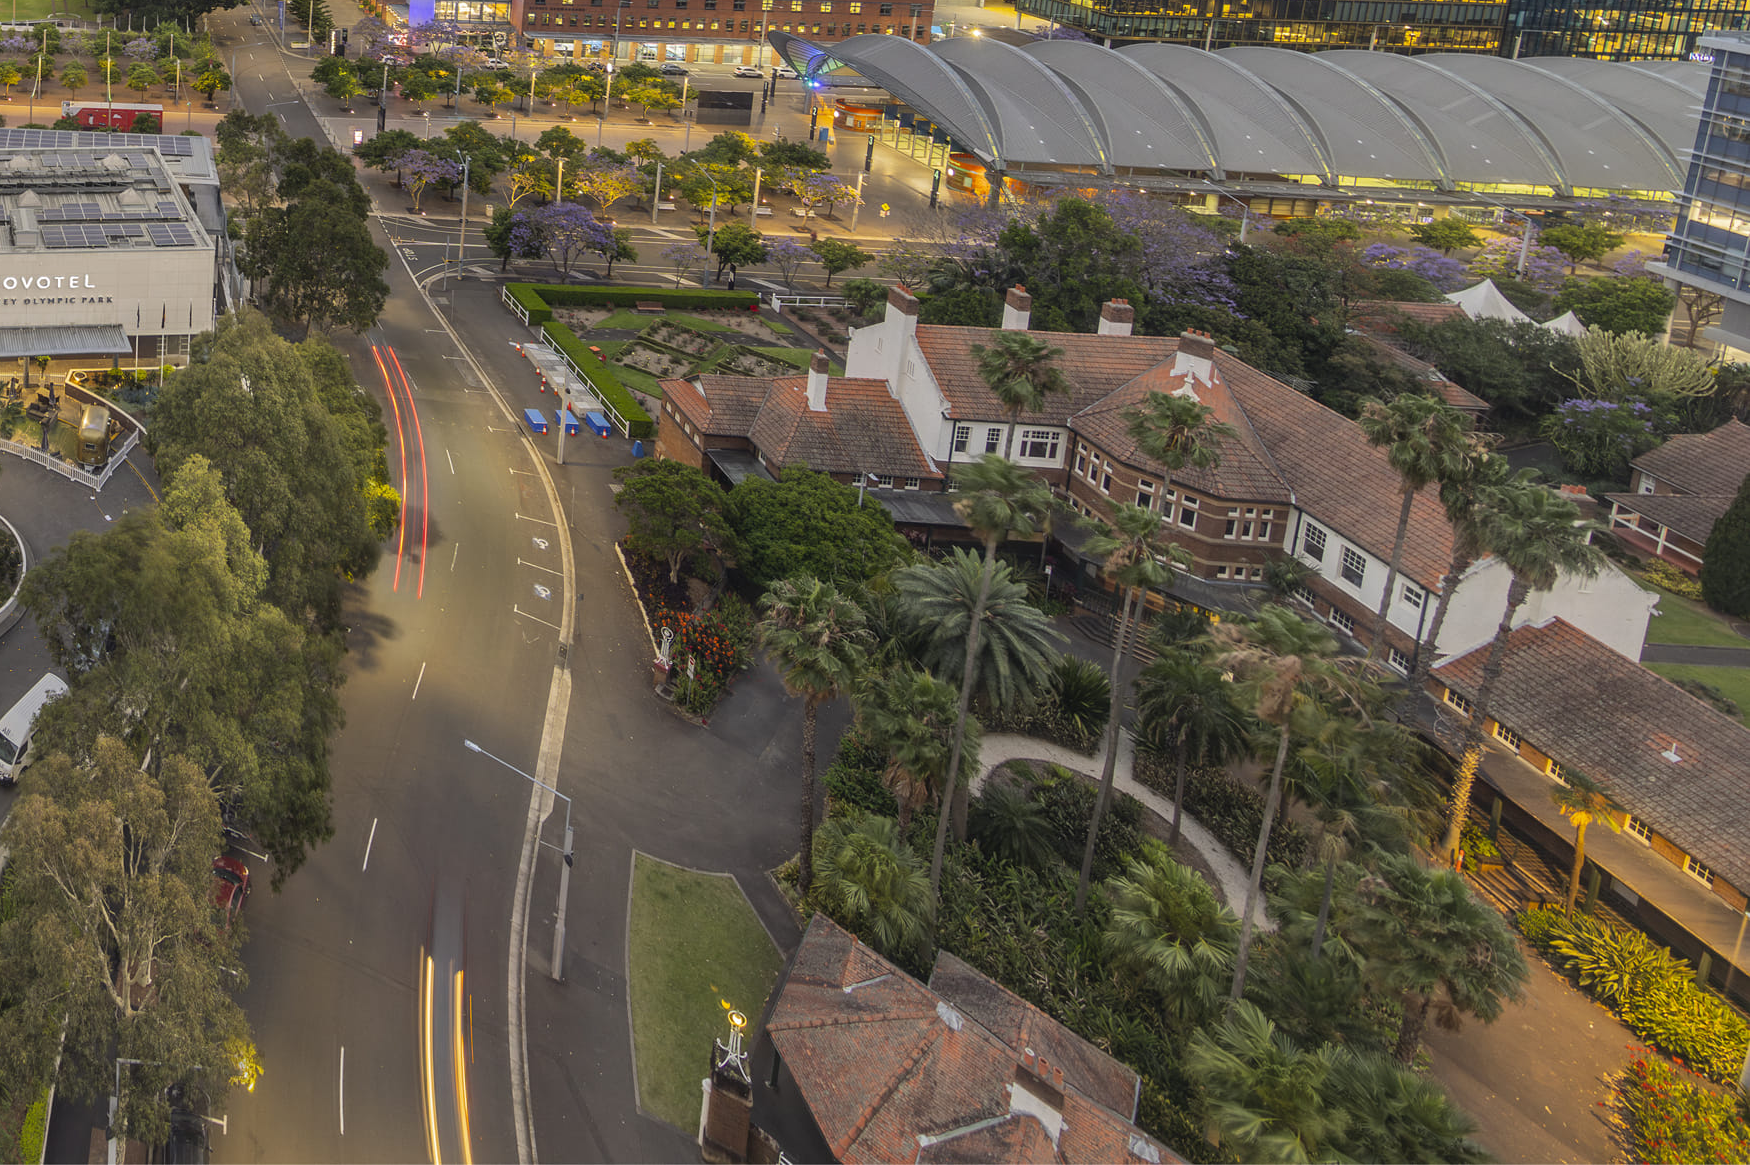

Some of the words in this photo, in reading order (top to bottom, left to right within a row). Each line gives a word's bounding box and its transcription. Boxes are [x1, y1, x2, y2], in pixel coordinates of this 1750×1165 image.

[812, 108, 817, 116] 2
[868, 136, 874, 146] 3
[933, 169, 940, 179] 4
[24, 297, 76, 306] OLYMPIC
[81, 296, 113, 304] PARK
